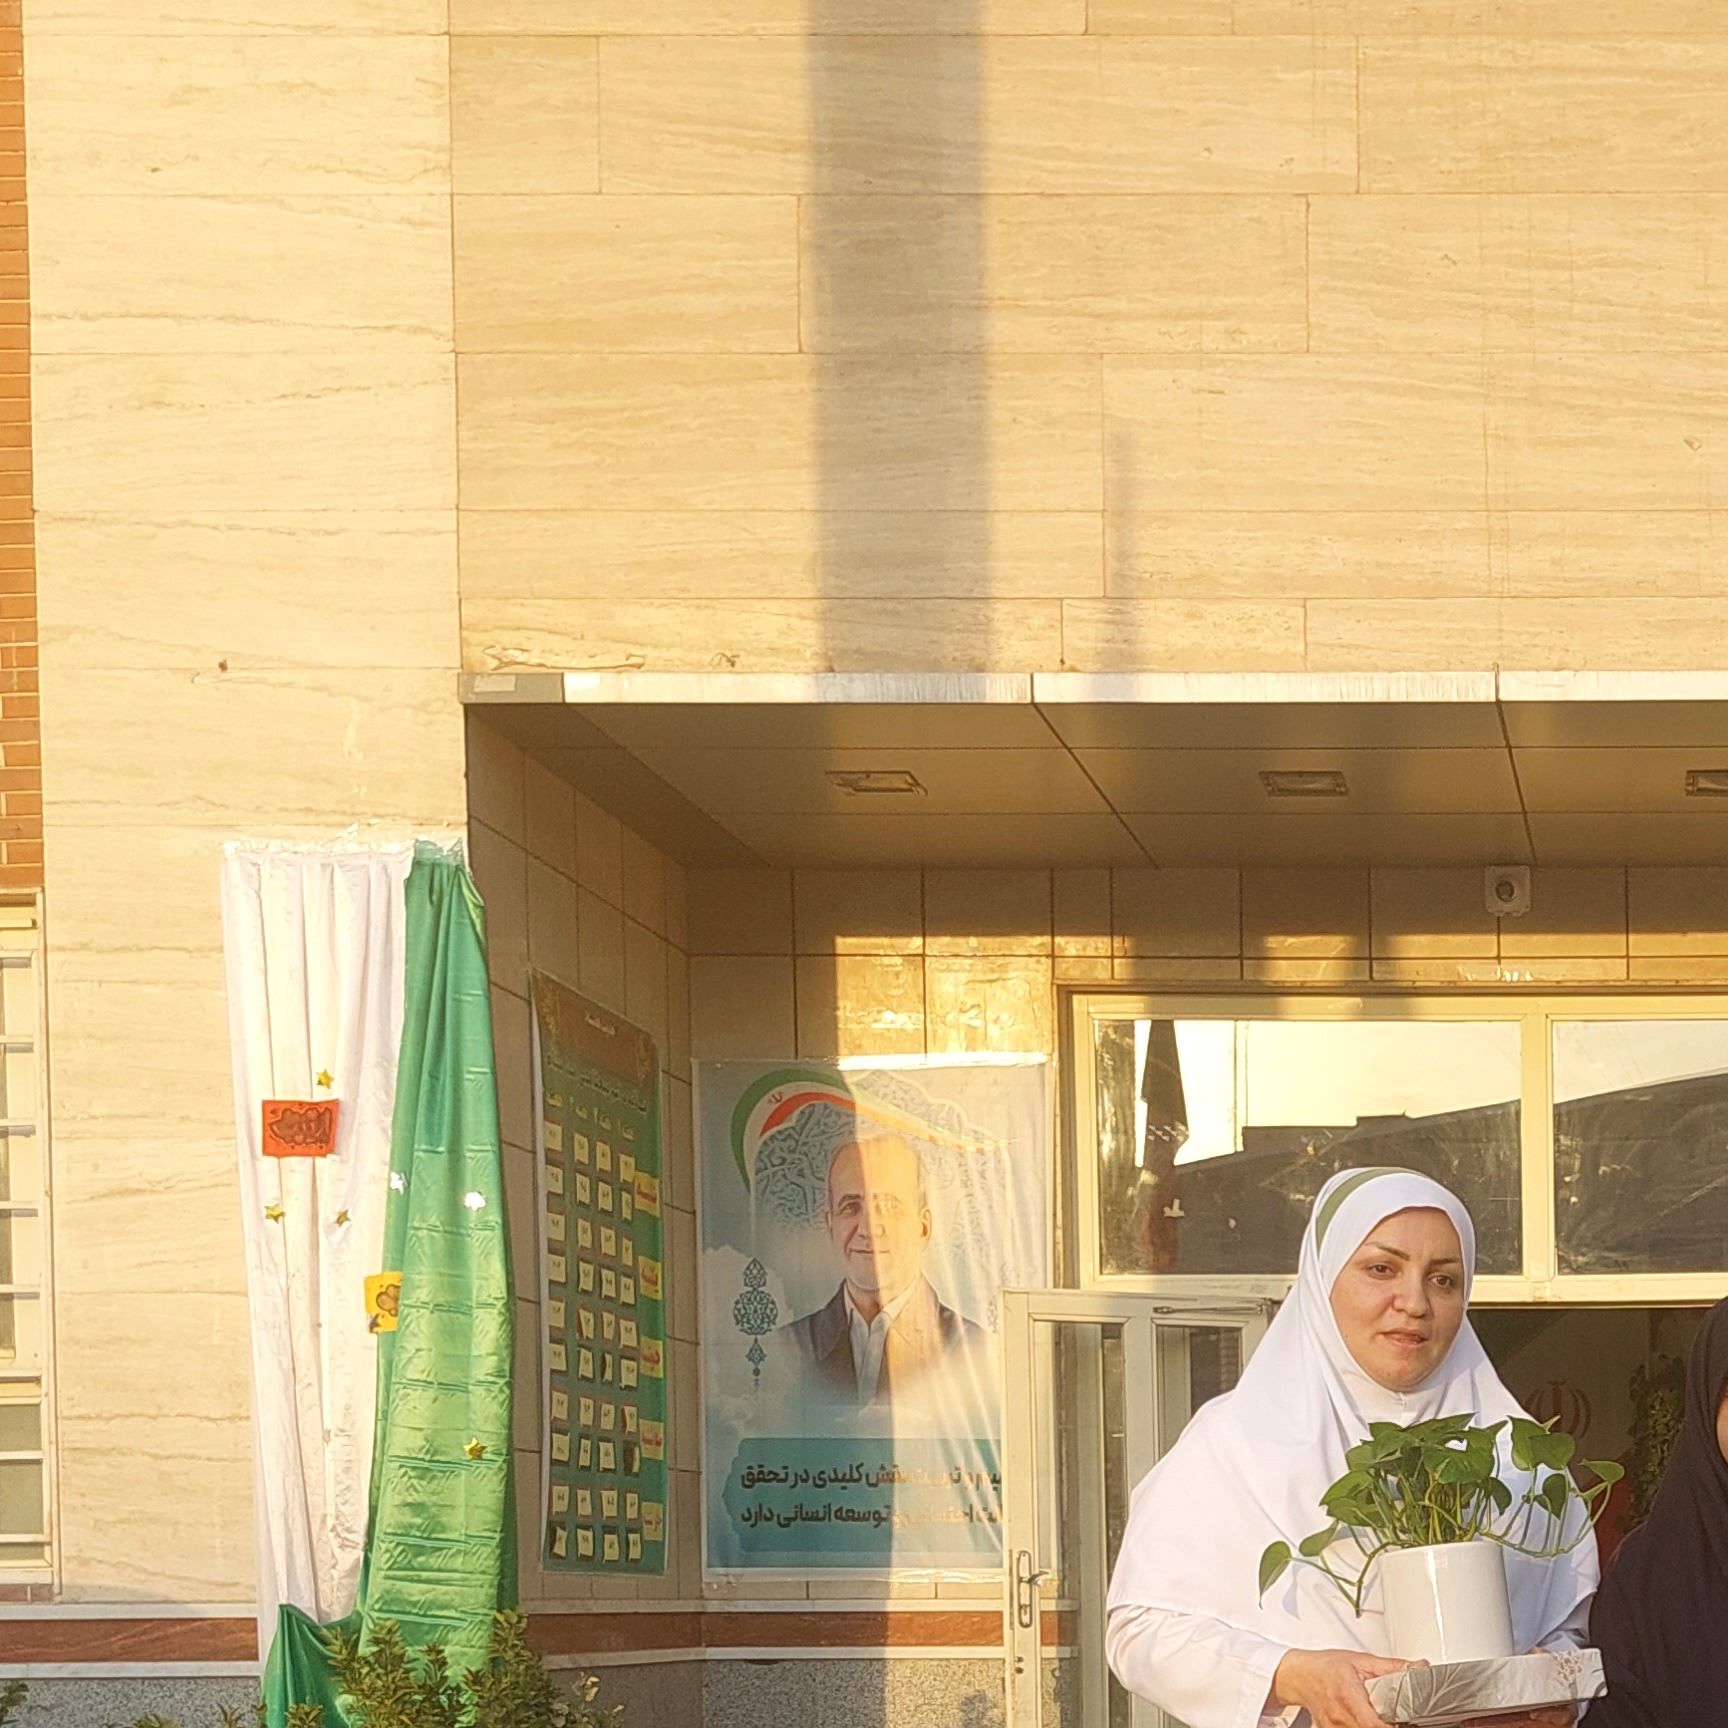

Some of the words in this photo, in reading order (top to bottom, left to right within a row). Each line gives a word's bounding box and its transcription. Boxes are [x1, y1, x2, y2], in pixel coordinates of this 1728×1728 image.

[741, 1464, 789, 1489] تحقق
[789, 1468, 810, 1489] در
[812, 1462, 864, 1490] کلیدی
[741, 1502, 775, 1528] دارد
[777, 1502, 831, 1528] انسانی
[834, 1504, 891, 1529] توسعه
